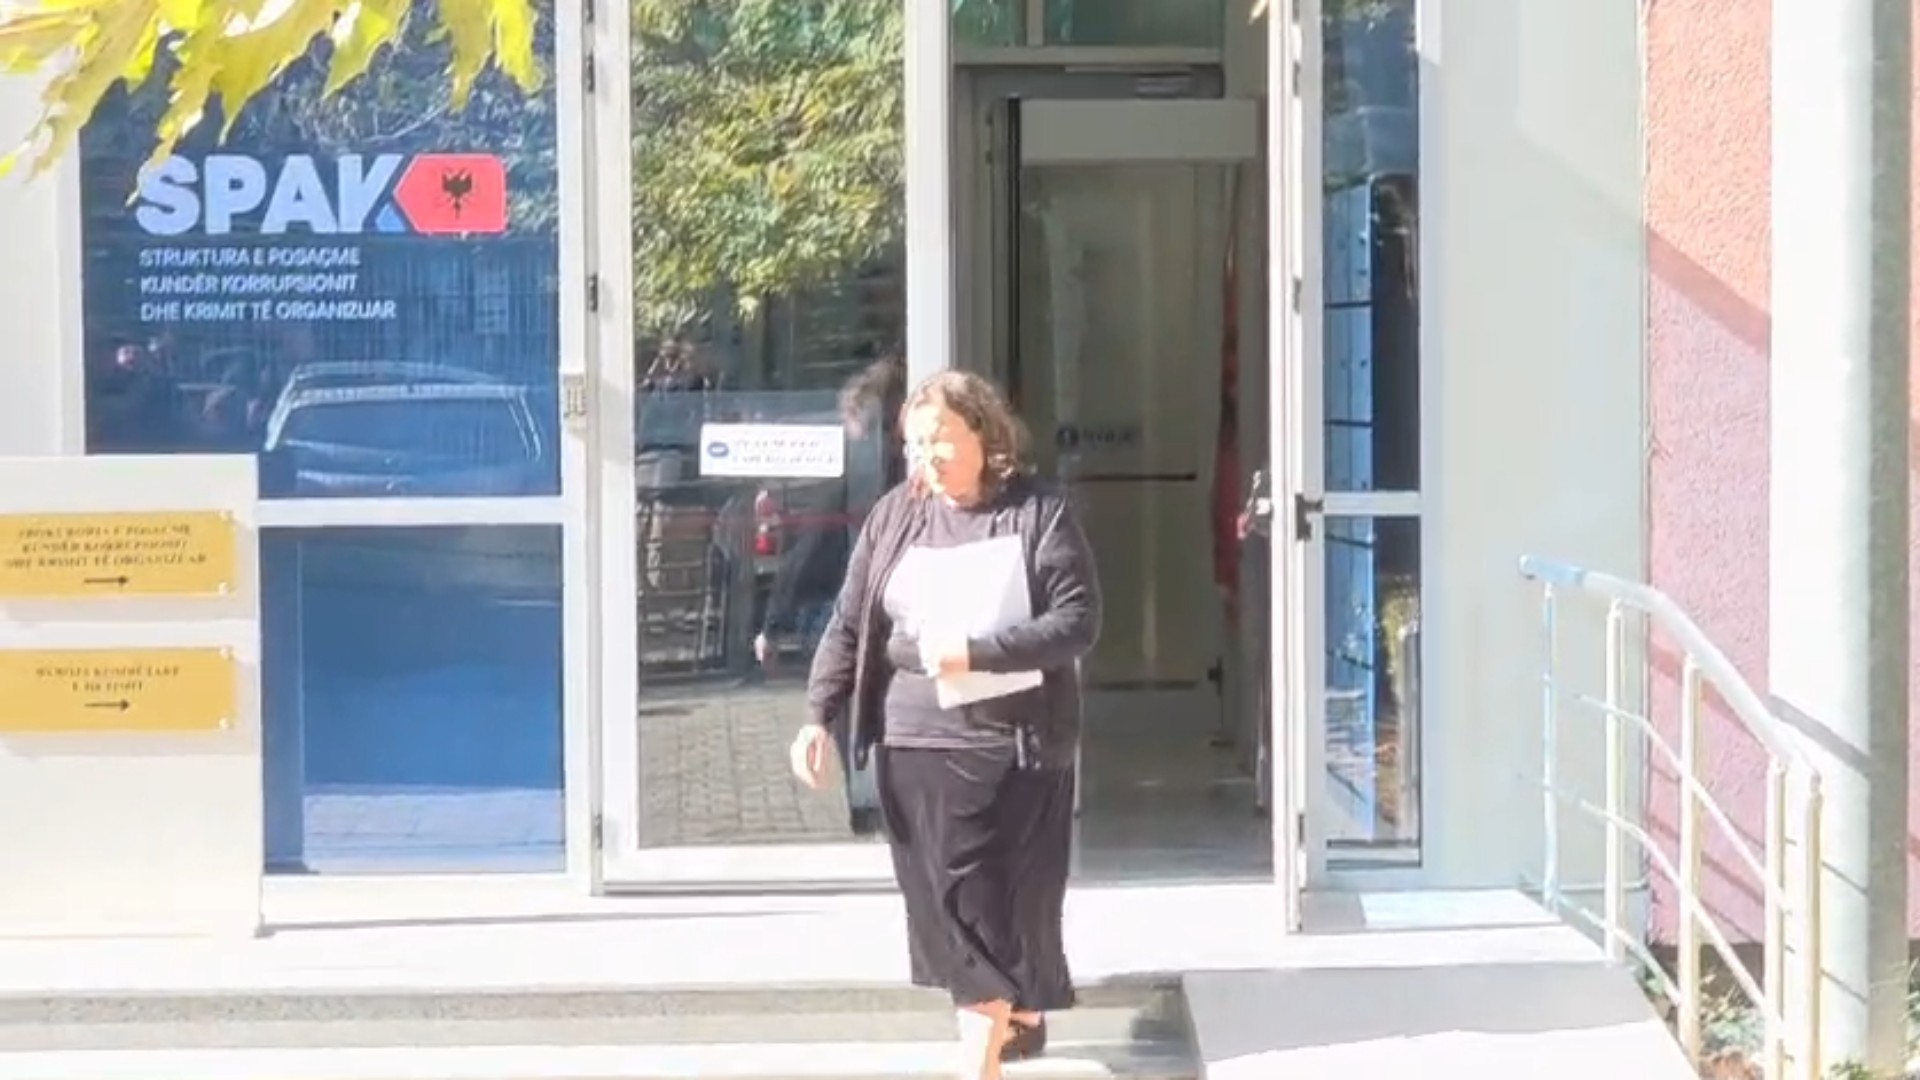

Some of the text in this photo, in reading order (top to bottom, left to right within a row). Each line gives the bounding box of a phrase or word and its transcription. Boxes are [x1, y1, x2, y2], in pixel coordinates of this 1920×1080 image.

[135, 154, 407, 235] SPAK
[140, 247, 360, 269] STRUKTURA E POSAÇME
[141, 273, 357, 294] KUNDËR KORRUPSIONIT
[141, 302, 180, 321] DHE
[184, 301, 247, 320] KRIMIT
[275, 300, 396, 320] ORGANIZUAR
